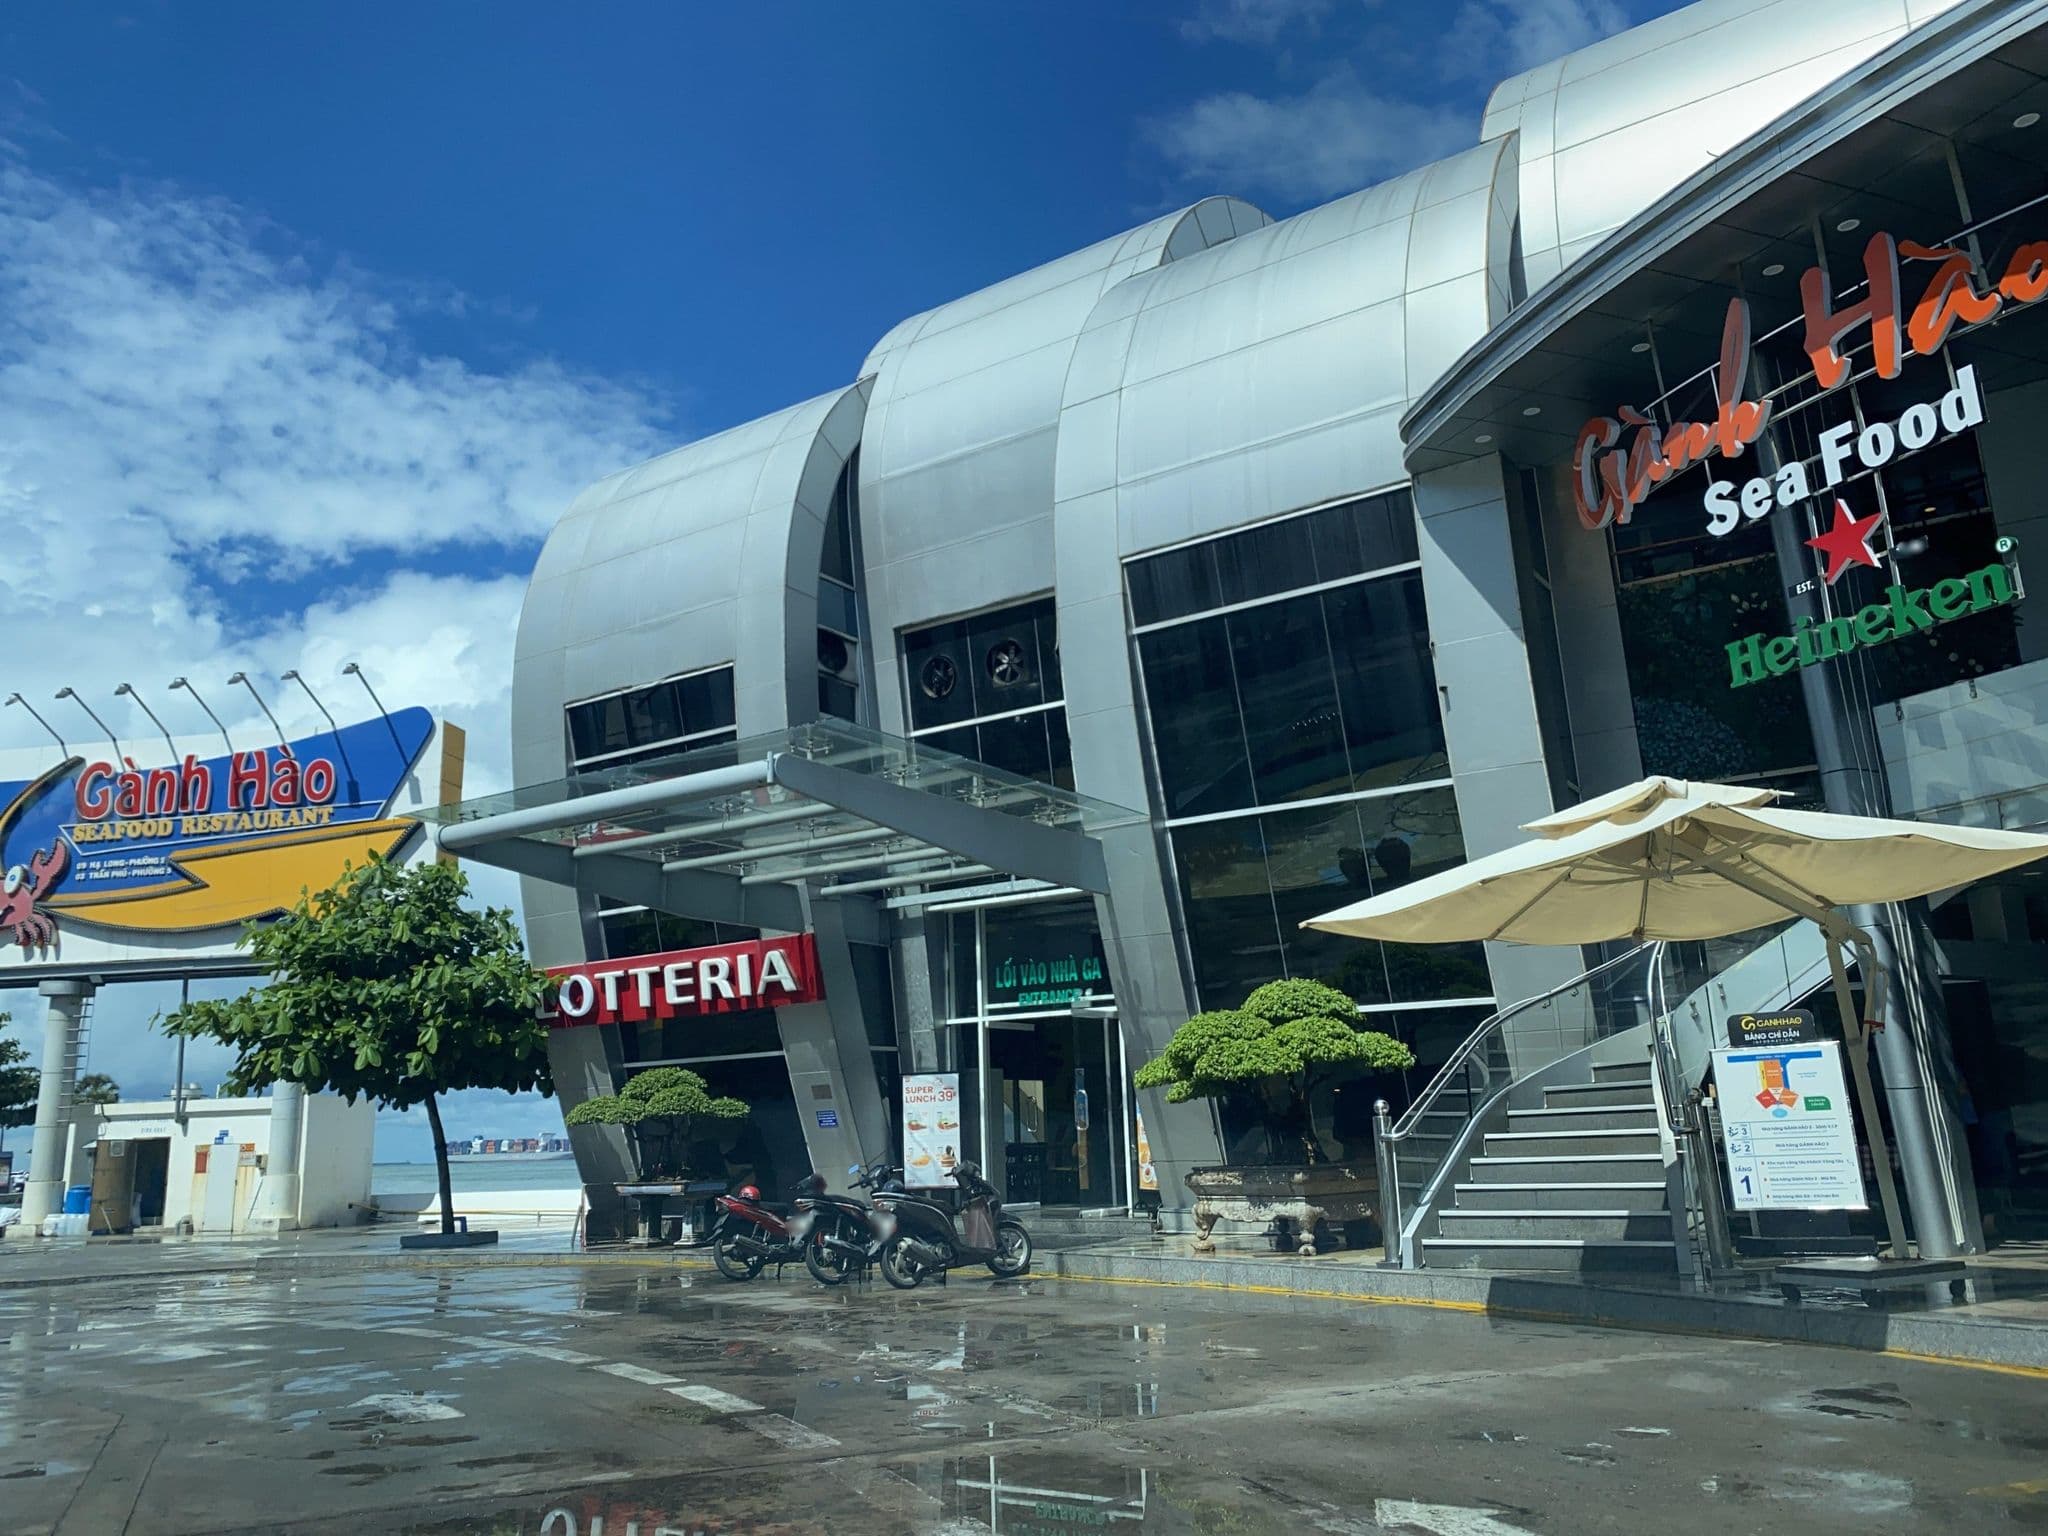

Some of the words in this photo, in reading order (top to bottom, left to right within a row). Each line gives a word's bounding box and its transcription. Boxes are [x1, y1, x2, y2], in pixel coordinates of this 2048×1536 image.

[1572, 297, 1773, 529] Gành
[1703, 460, 1810, 537] Sea
[1818, 363, 1987, 487] Food
[1795, 580, 1815, 594] EST.
[1725, 562, 2020, 688] Heineken
[75, 753, 211, 821] Gành
[228, 744, 336, 810] Hào
[73, 819, 174, 843] SEAFOOD
[181, 807, 334, 835] RESTAURANT
[995, 957, 1017, 988] LỐI
[1020, 958, 1047, 986] VÀO
[1050, 954, 1078, 983] NHÀ
[1082, 957, 1102, 980] GA
[905, 1086, 934, 1094] SUPER
[905, 1095, 937, 1104] LUNCH
[1745, 1144, 1751, 1152] 2
[1740, 1175, 1752, 1195] 1
